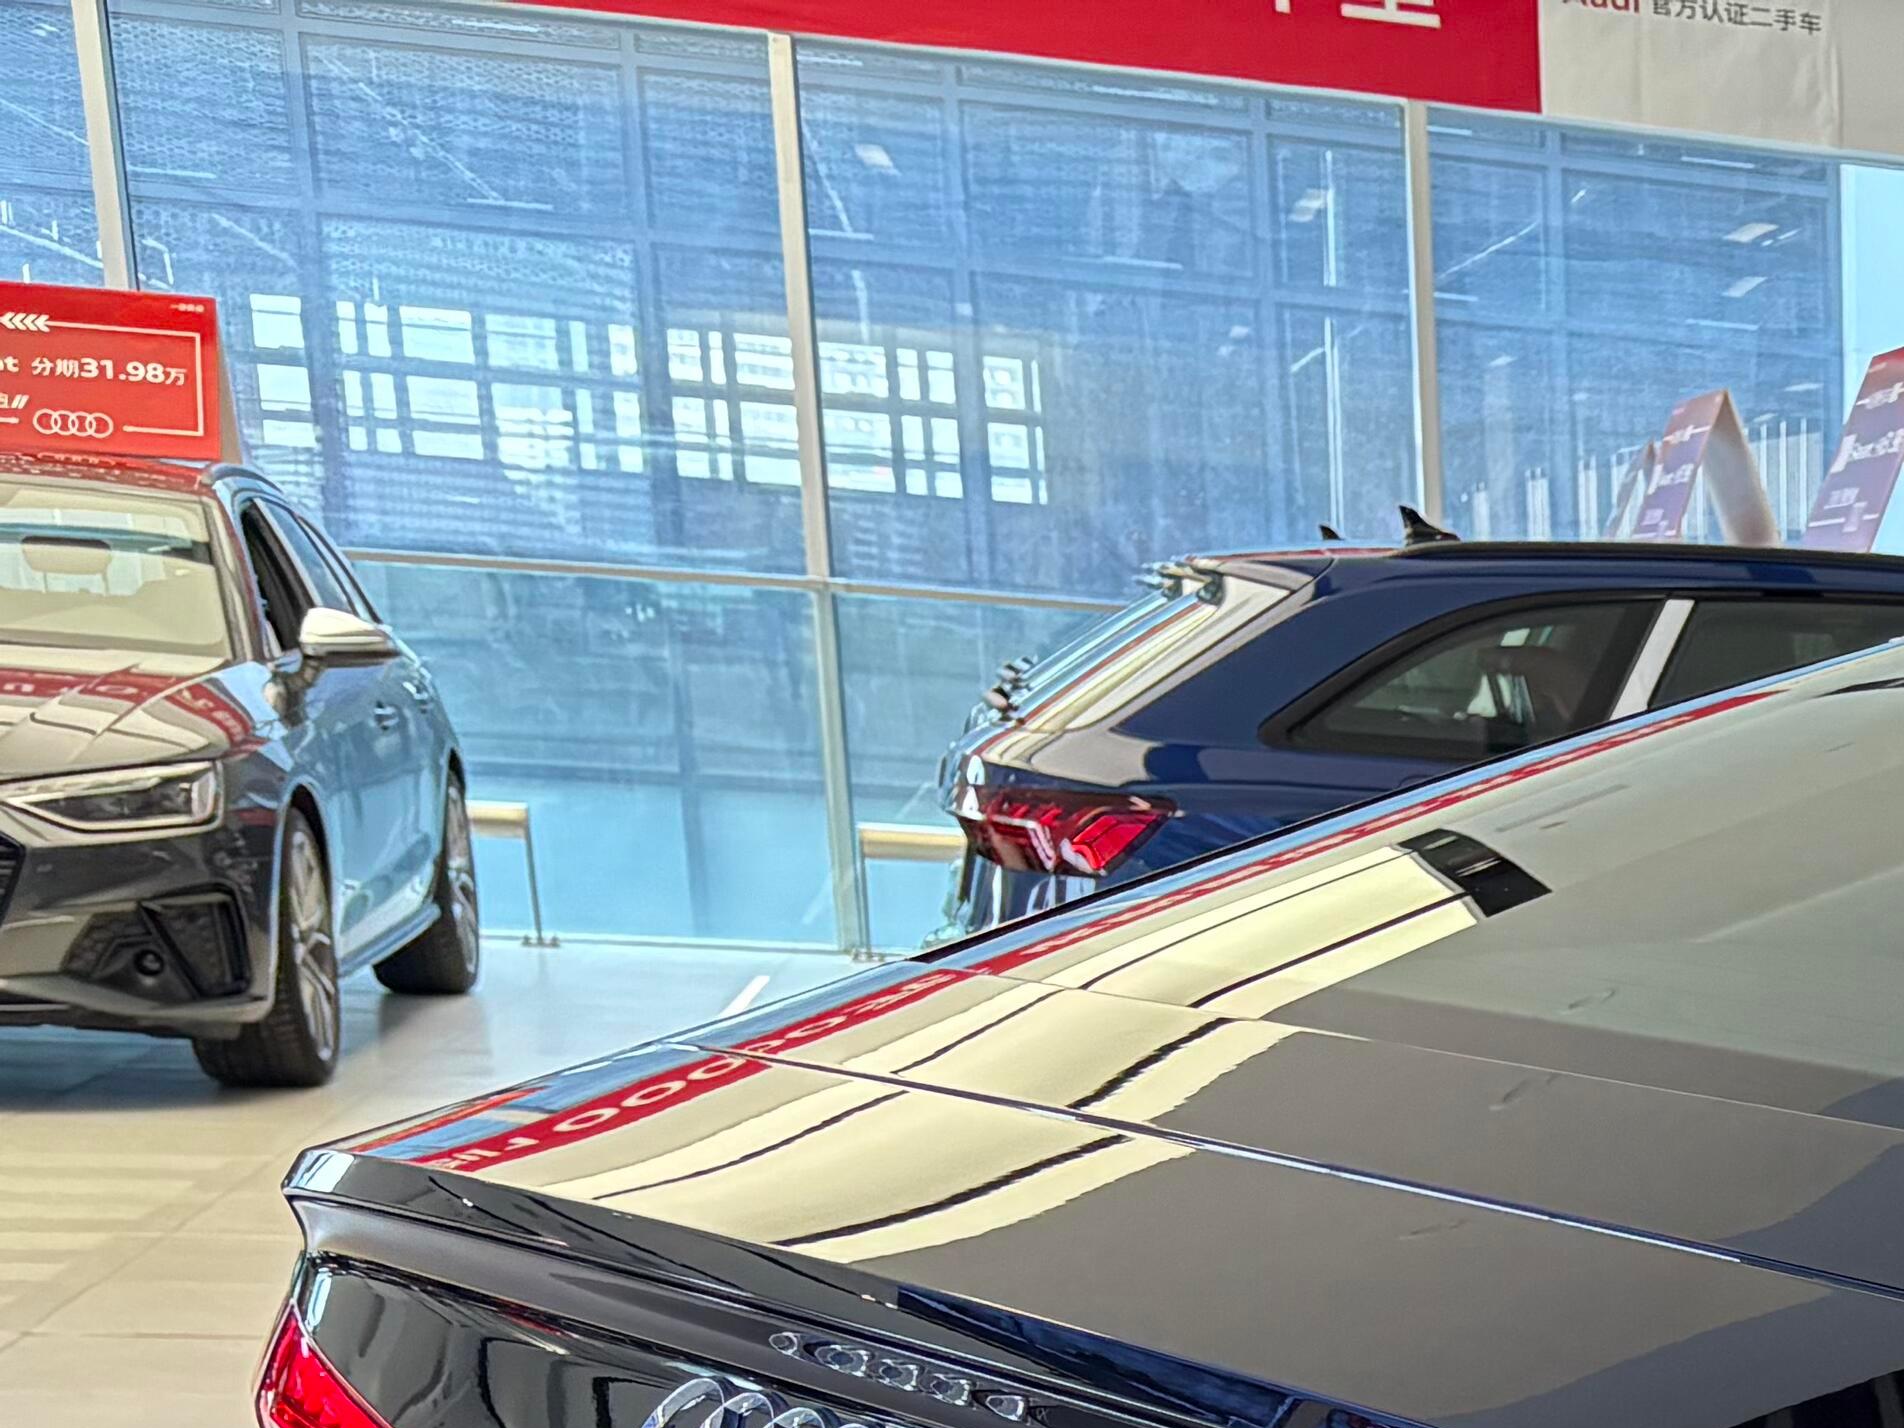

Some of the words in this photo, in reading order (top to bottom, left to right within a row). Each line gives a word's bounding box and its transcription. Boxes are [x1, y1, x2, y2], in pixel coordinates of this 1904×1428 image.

[1652, 0, 1822, 36] 官方认证二手车
[31, 356, 188, 386] 分期31.98万
